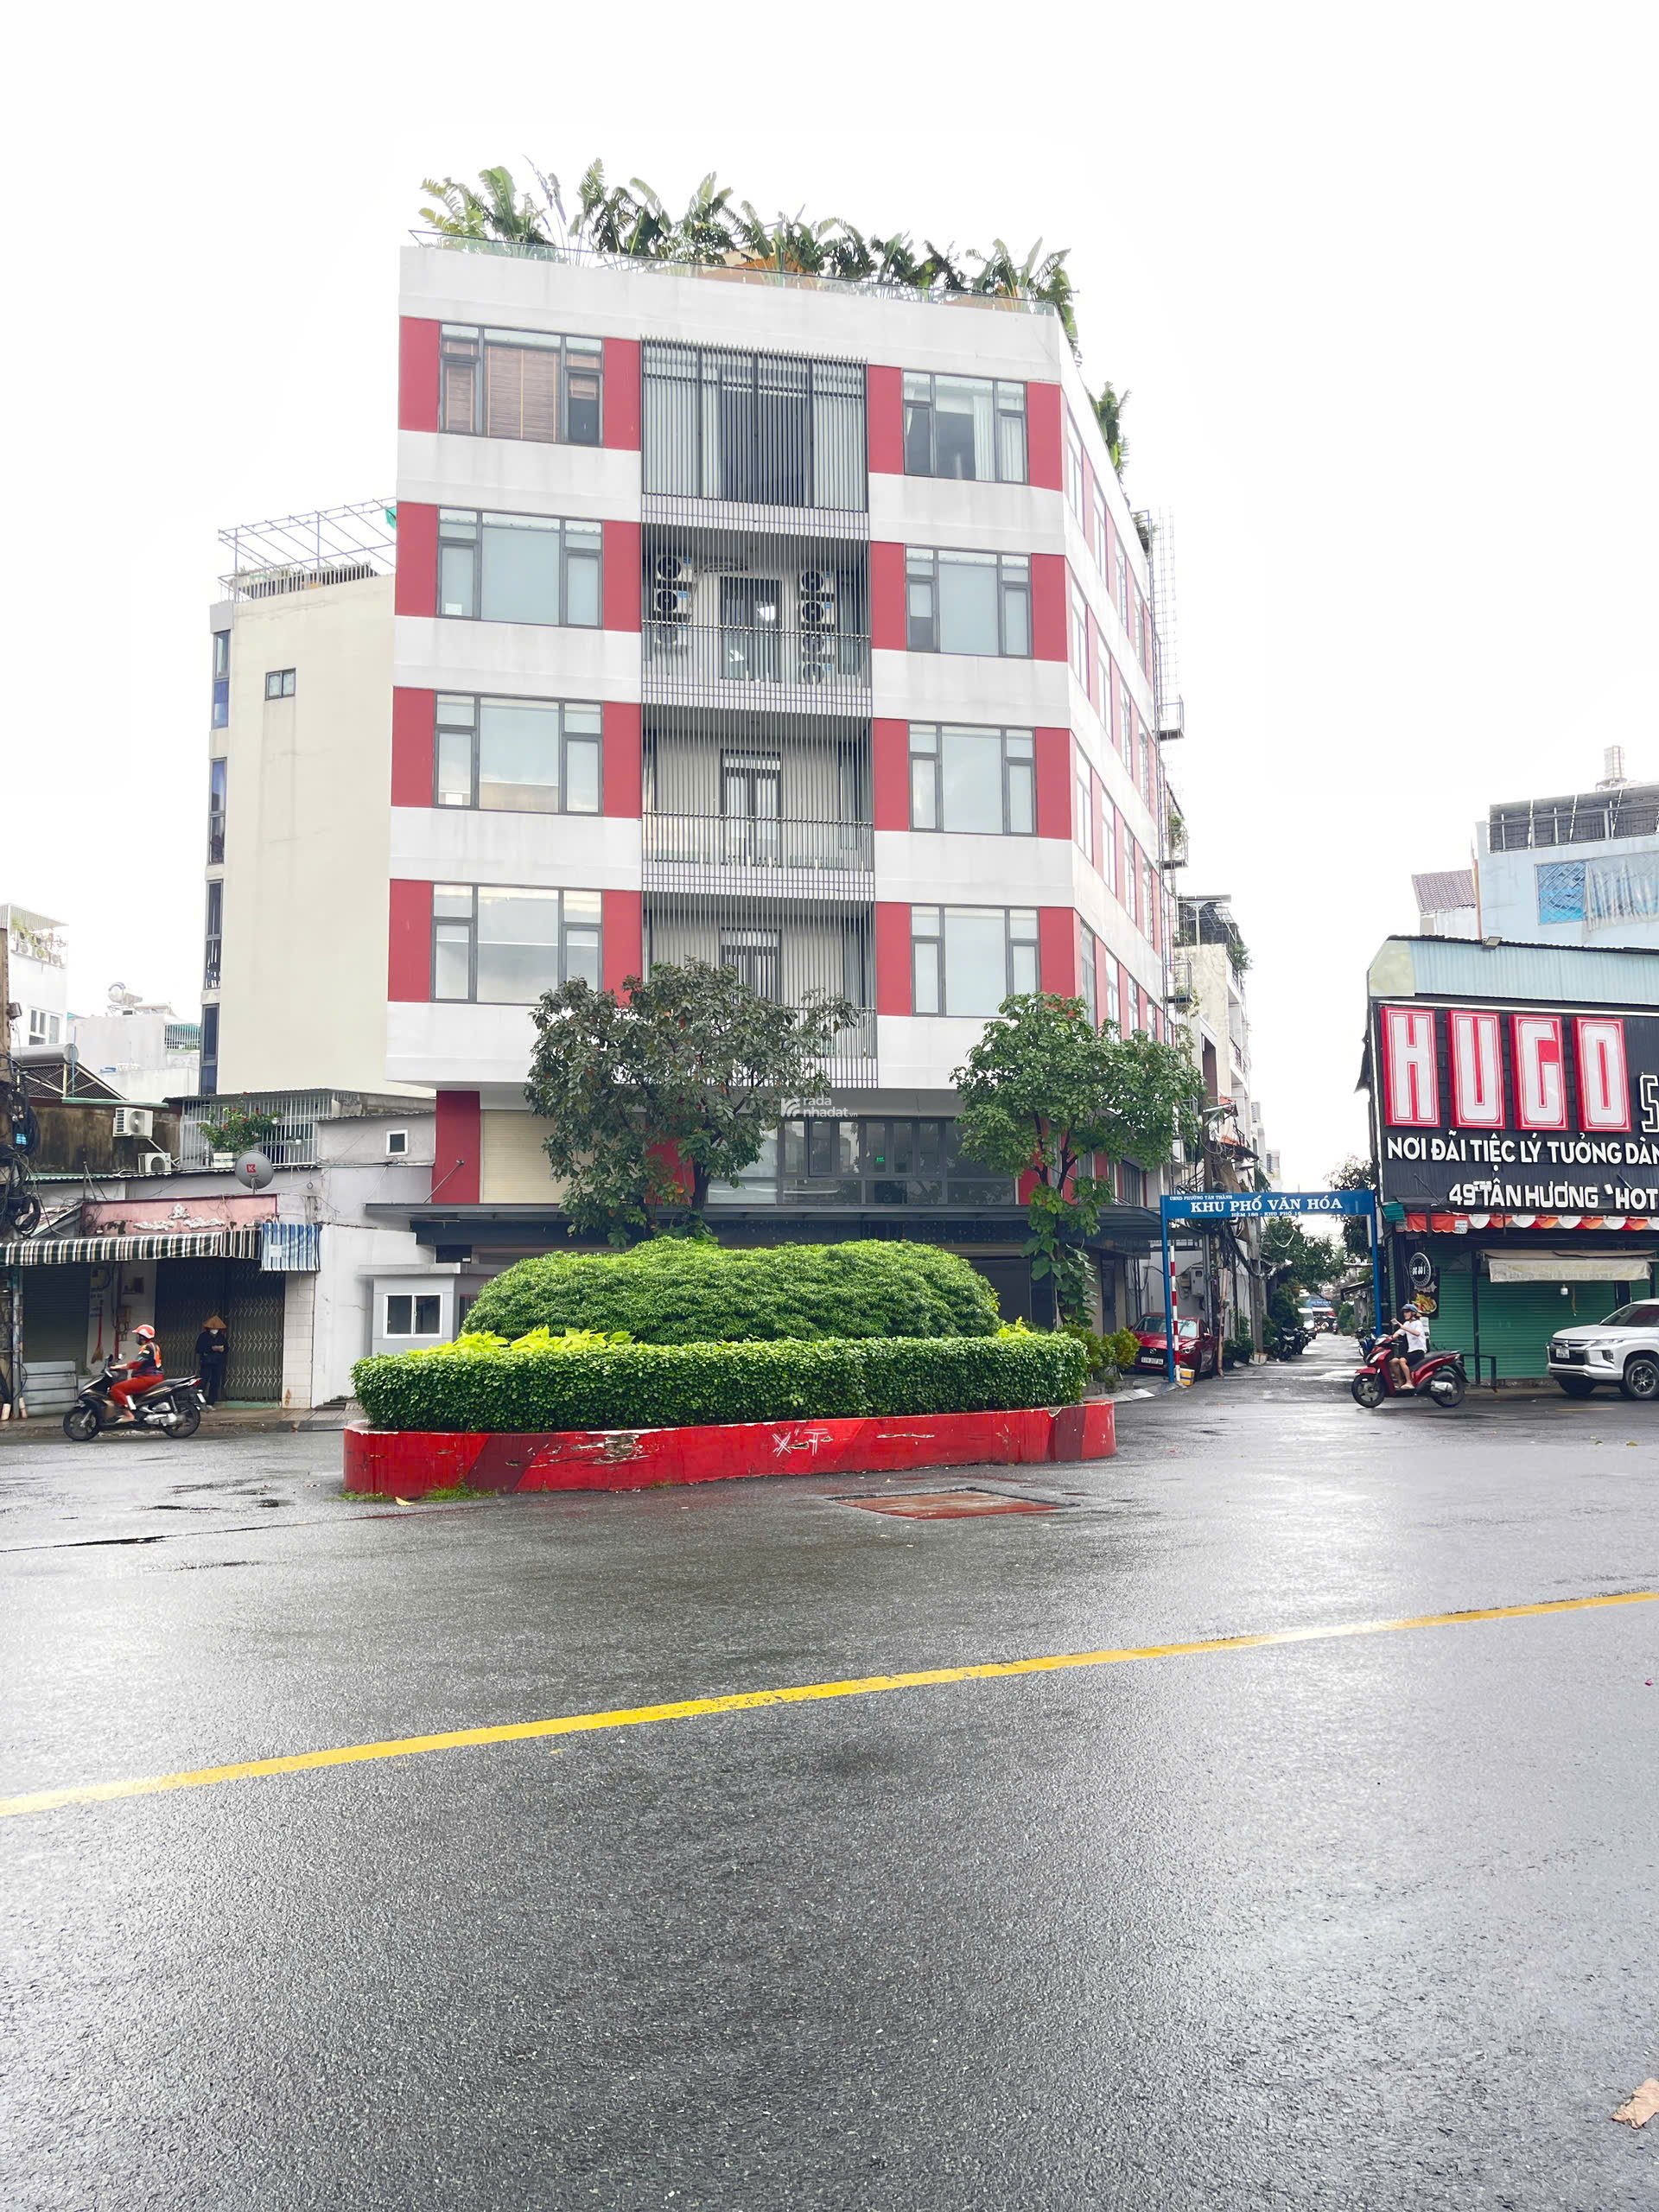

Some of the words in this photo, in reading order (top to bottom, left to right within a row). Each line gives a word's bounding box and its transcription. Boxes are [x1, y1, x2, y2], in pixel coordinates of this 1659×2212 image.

[1382, 1007, 1631, 1132] HUGO
[1387, 1137, 1427, 1160] NƠI
[1431, 1129, 1466, 1161] ĐÃI
[1470, 1132, 1516, 1172] TIỆC
[1520, 1132, 1541, 1163] LÝ
[1547, 1133, 1622, 1165] TƯỞNG
[1191, 1201, 1224, 1213] KHU
[1230, 1195, 1262, 1211] PHỐ
[1268, 1196, 1300, 1211] VĂN
[1306, 1195, 1343, 1210] HÓA
[1479, 1177, 1521, 1207] TÂN
[1524, 1180, 1599, 1209] HƯƠNG
